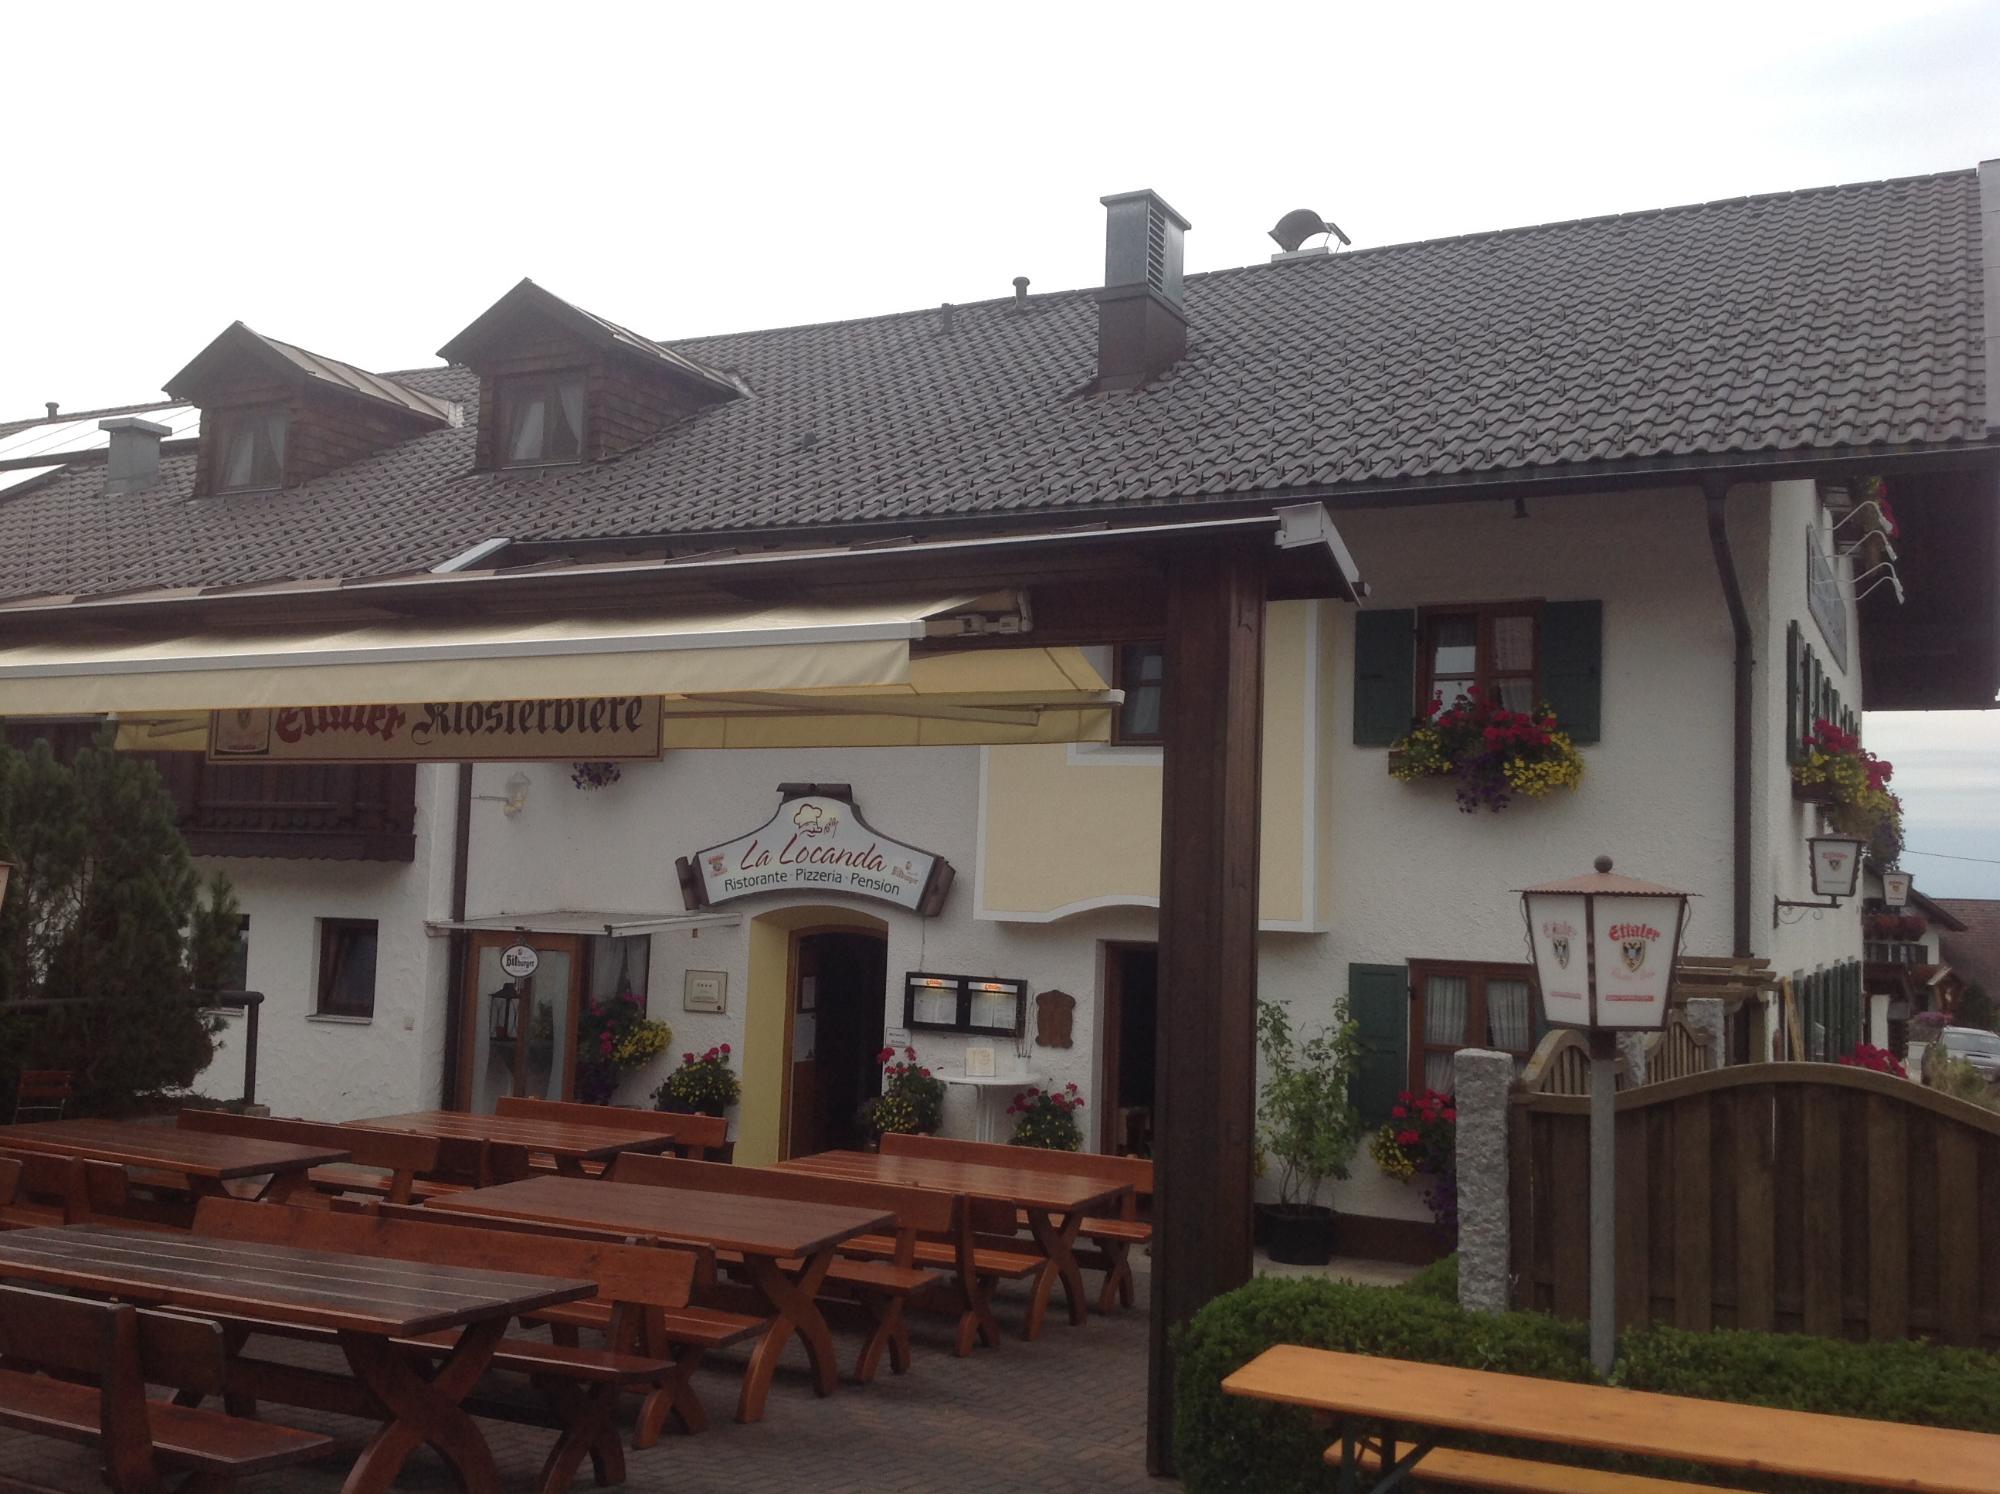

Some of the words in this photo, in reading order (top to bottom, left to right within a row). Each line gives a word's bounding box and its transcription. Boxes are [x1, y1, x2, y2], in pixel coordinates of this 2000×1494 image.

[740, 839, 772, 870] La
[779, 833, 887, 872] Locanda
[724, 871, 788, 892] Ristorante
[795, 868, 842, 884] Pizzeria
[850, 872, 900, 896] Pension
